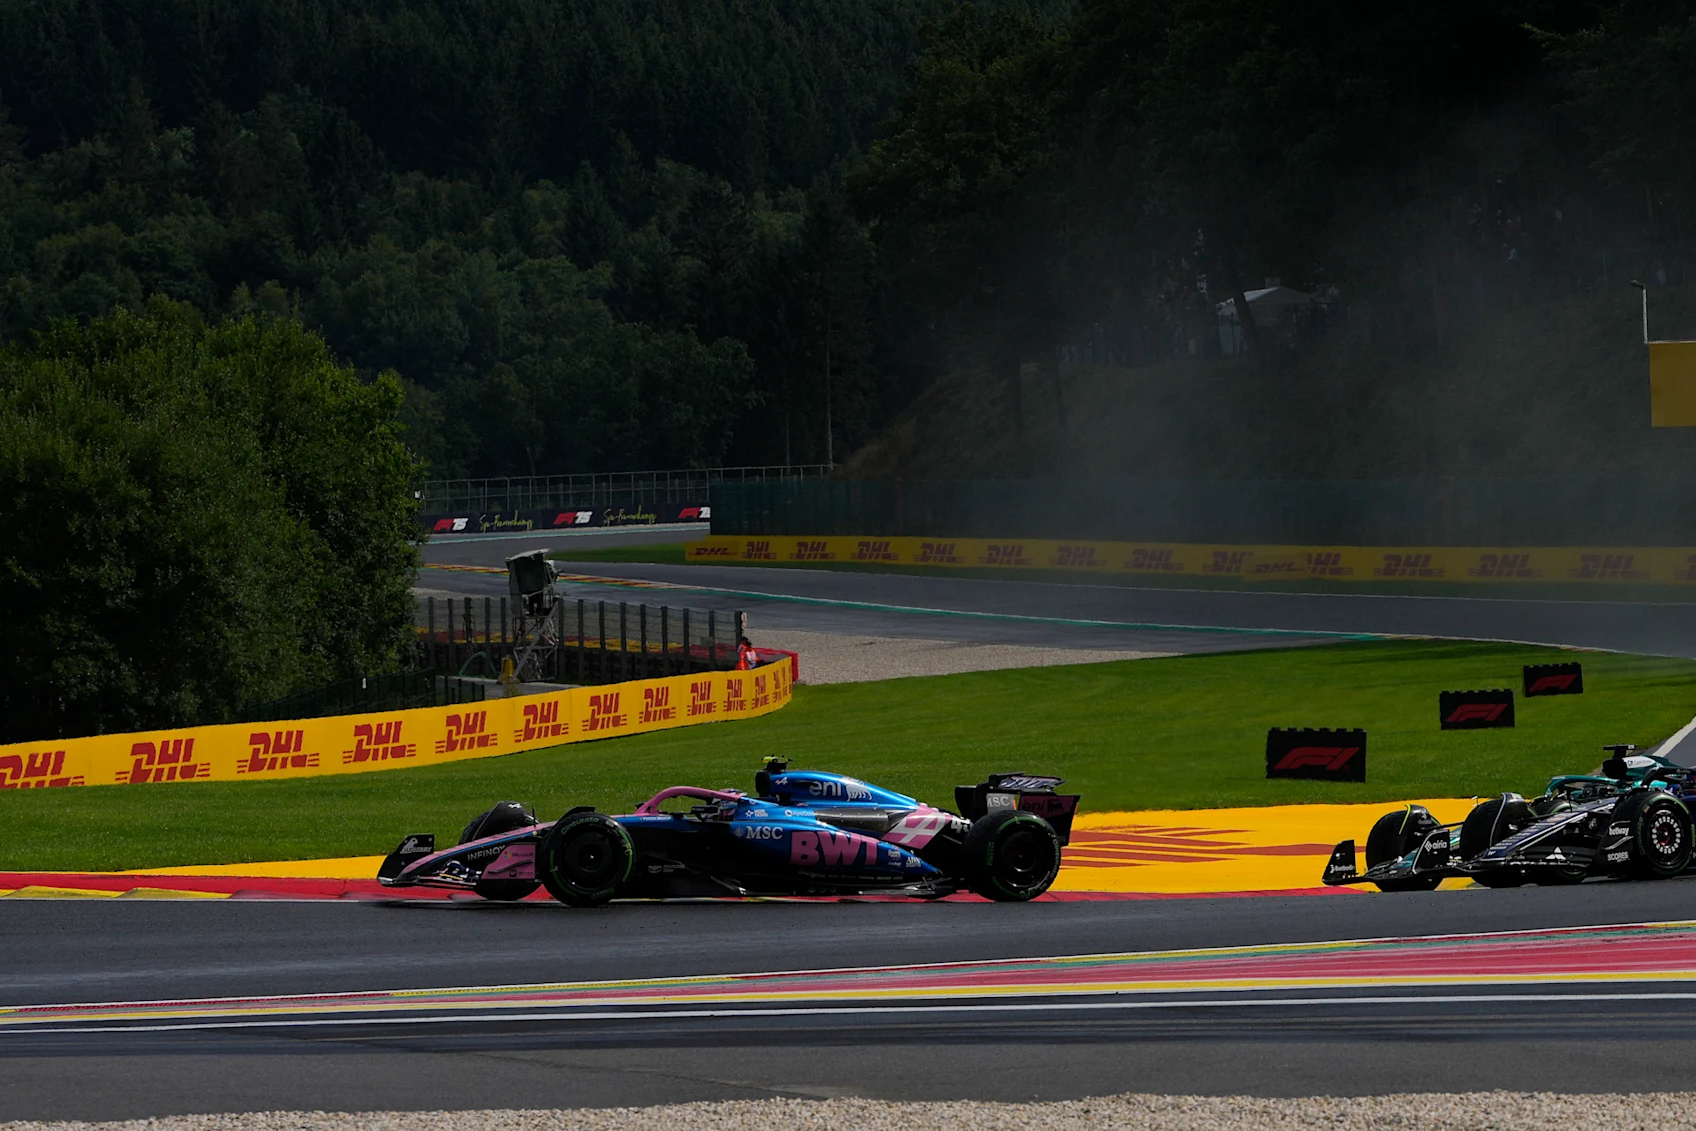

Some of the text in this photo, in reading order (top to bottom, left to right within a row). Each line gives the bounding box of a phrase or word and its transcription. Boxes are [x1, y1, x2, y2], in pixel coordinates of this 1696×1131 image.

[746, 541, 772, 559] DHL
[796, 541, 830, 559] DHL
[857, 541, 894, 560] DHL
[919, 543, 956, 563] DHL
[986, 544, 1025, 565] DHL
[1056, 546, 1099, 567] DHL
[1382, 554, 1433, 577] DHL
[1478, 554, 1531, 578] DHL
[643, 686, 671, 722] DHL
[690, 680, 713, 715] DHL
[726, 678, 743, 711] DHL
[523, 700, 562, 742] DHL
[588, 692, 621, 731] DHL
[352, 721, 407, 763] DHL
[445, 710, 490, 752] DHL
[129, 738, 199, 784] DHL
[247, 730, 308, 772] DHL
[808, 780, 842, 796] eni
[1022, 799, 1045, 813] eni
[746, 825, 783, 840] MSC
[789, 830, 879, 866] BWT
